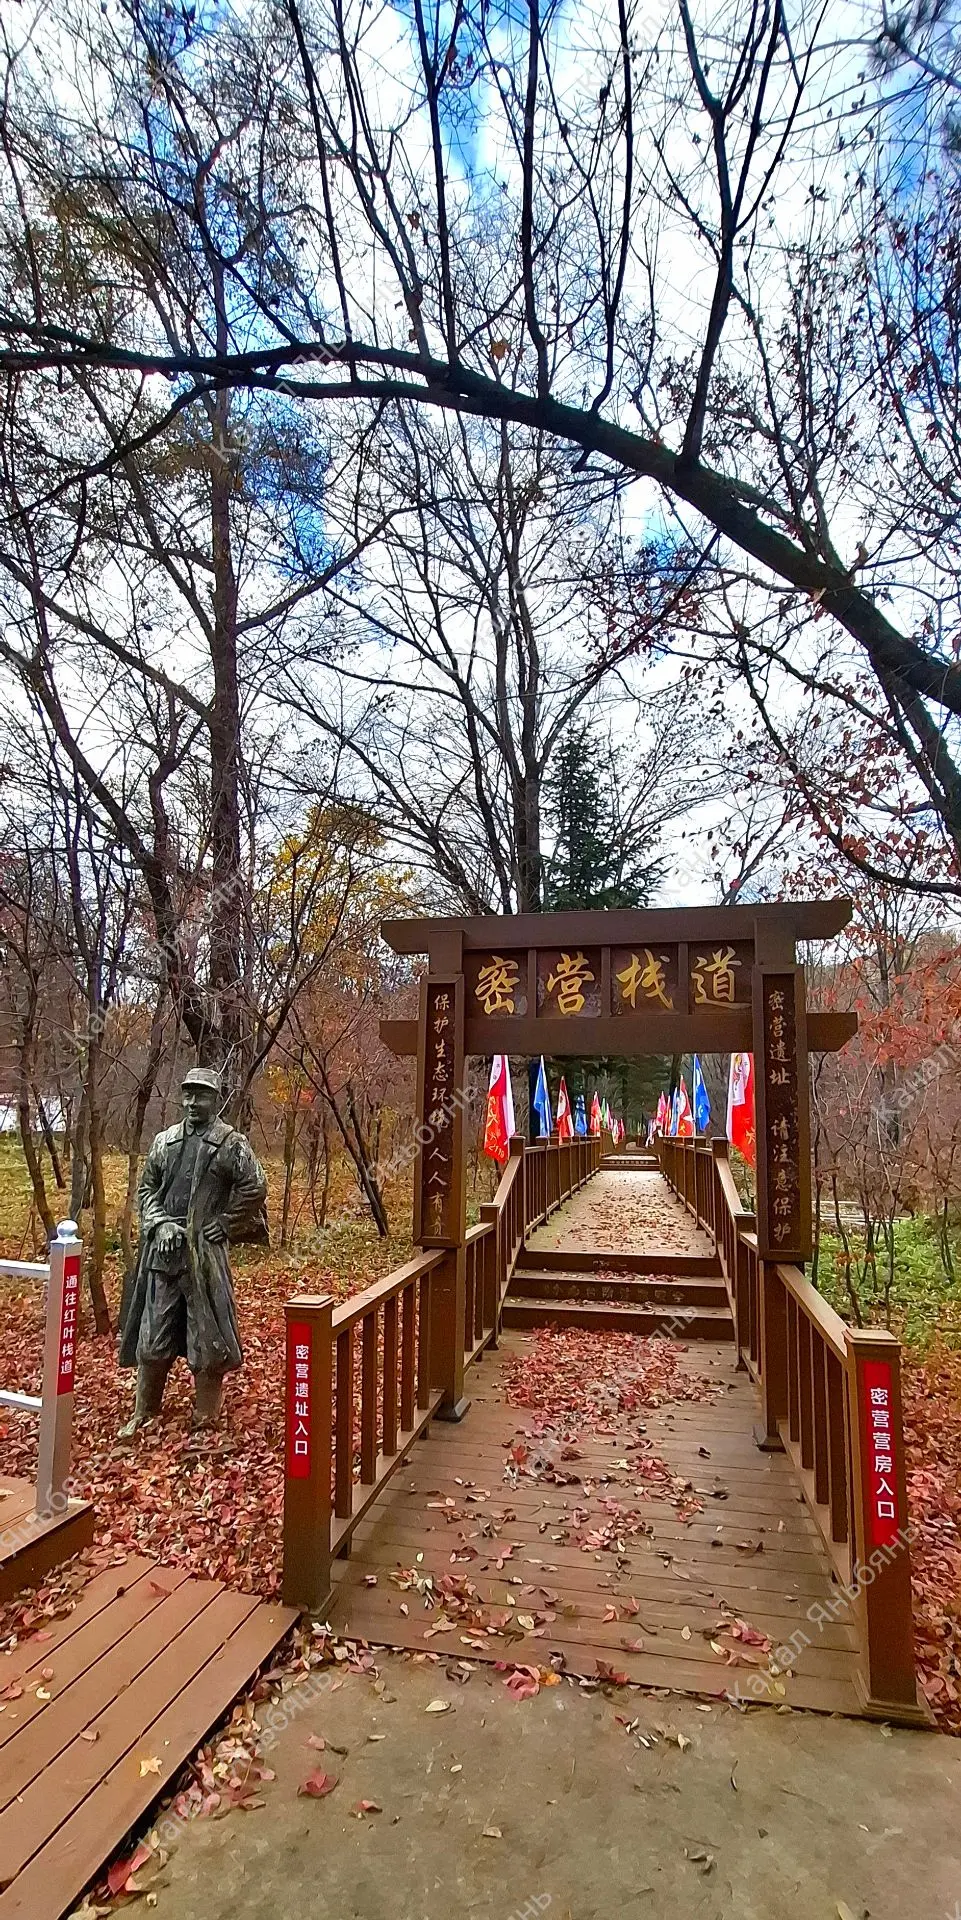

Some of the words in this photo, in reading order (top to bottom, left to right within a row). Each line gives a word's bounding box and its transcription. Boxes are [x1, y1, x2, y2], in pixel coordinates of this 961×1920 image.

[474, 946, 752, 1016] 密营栈道
[768, 990, 791, 1086] 密营遗址
[770, 1119, 793, 1242] 请注意保护
[60, 1275, 78, 1375] 通往红叶栈道
[294, 1344, 310, 1456] 密营遗址入口
[870, 1387, 896, 1520] 密营营房入口
